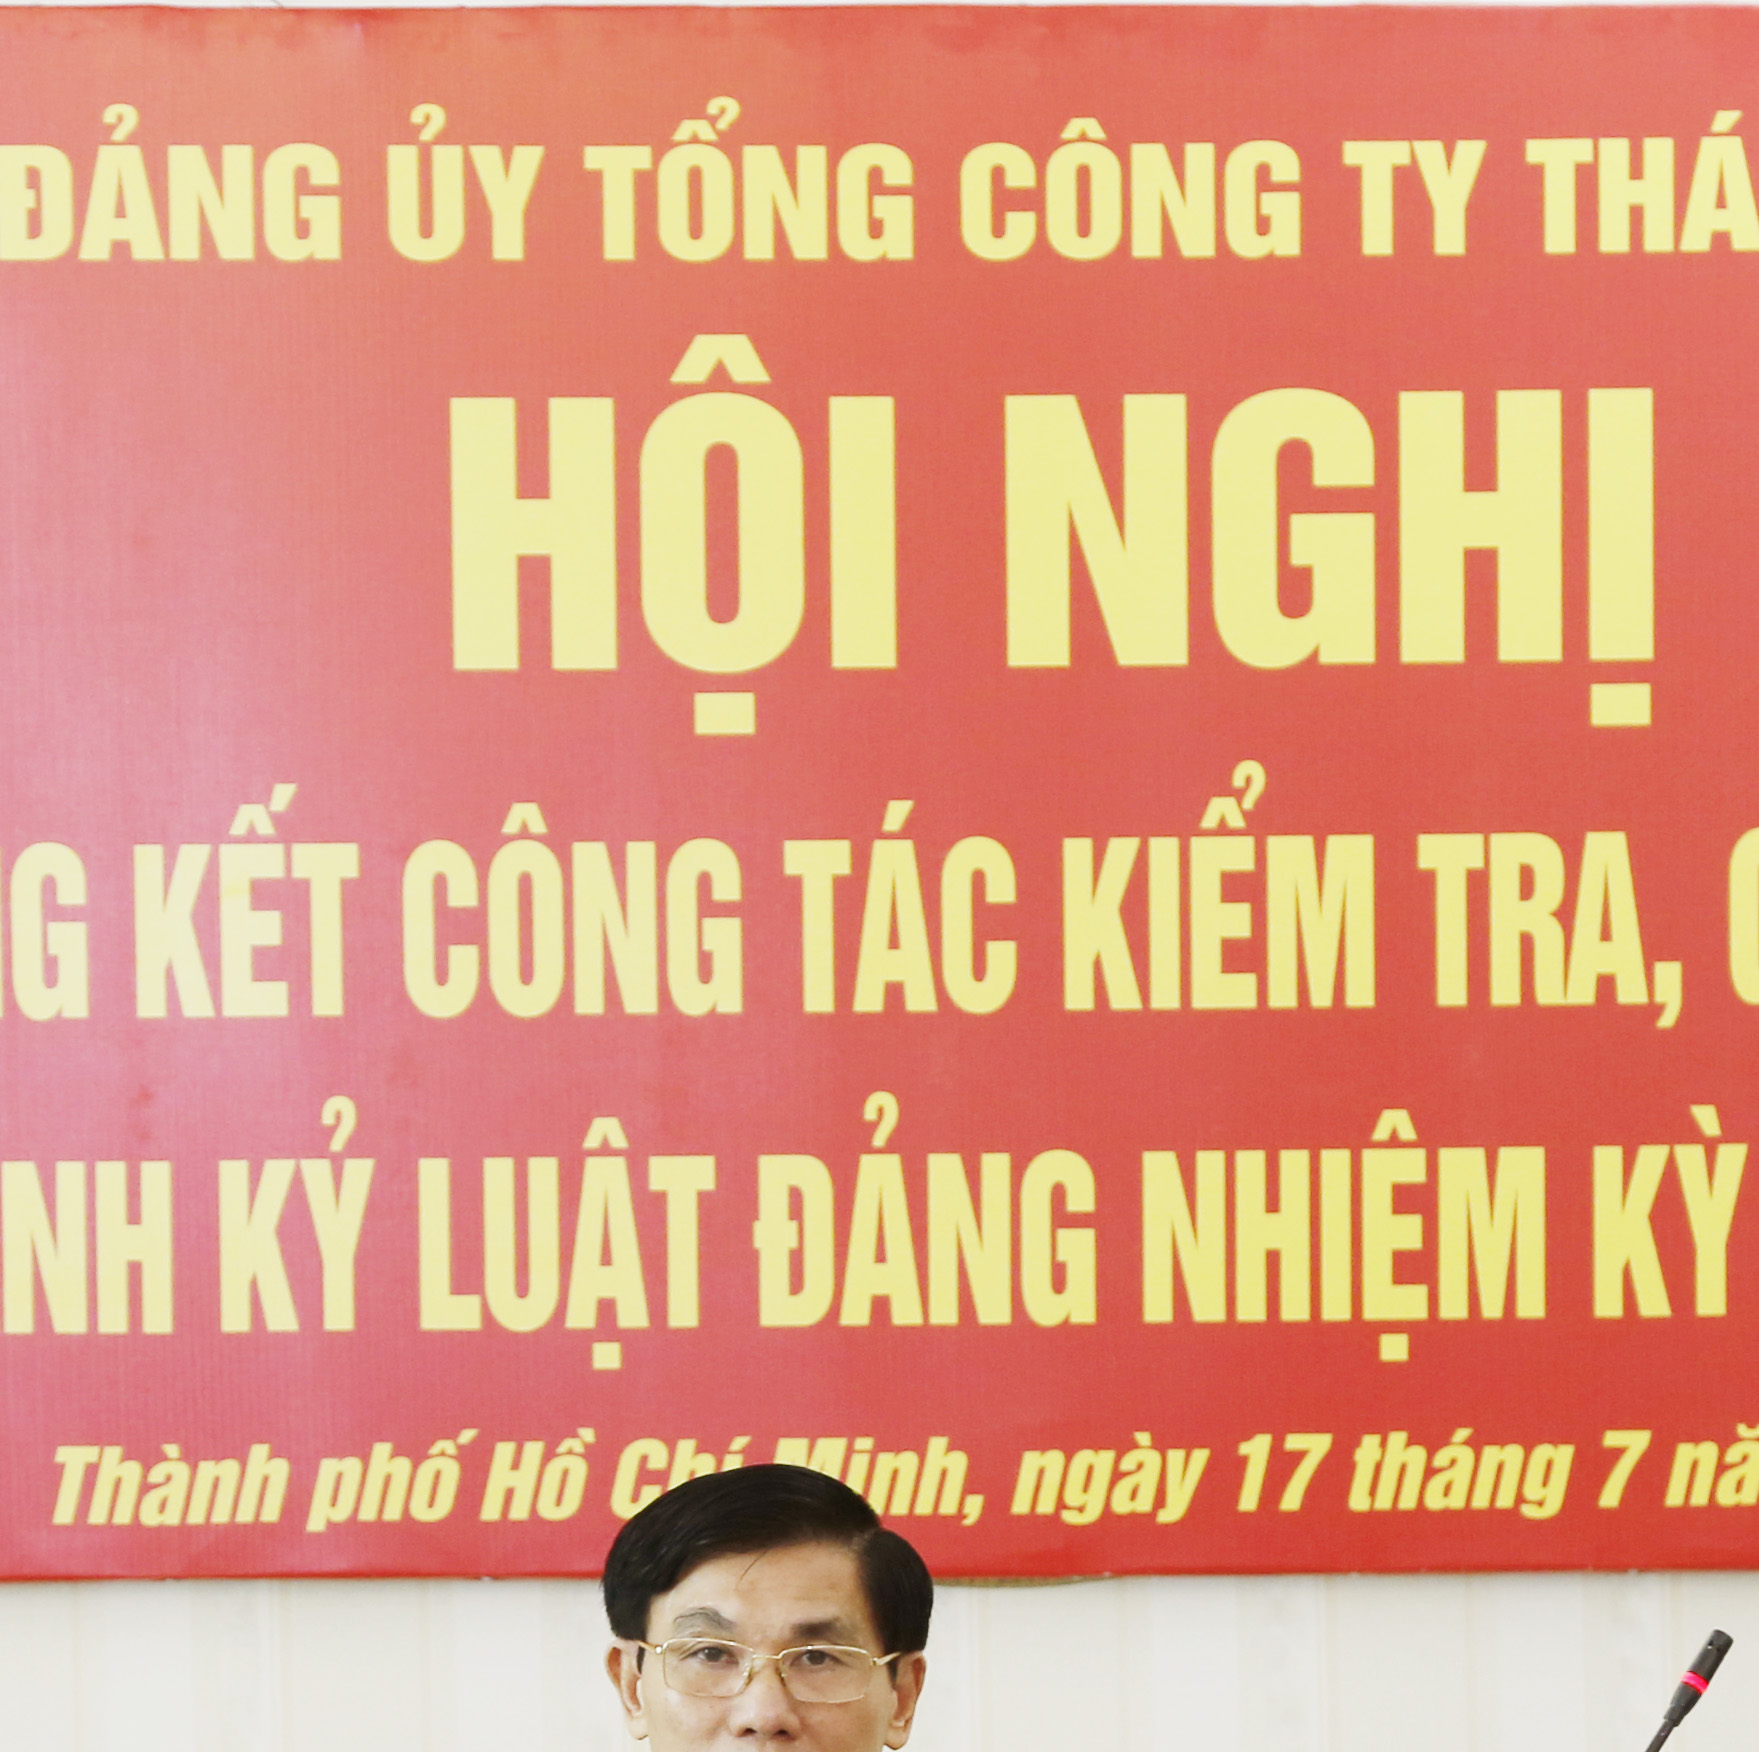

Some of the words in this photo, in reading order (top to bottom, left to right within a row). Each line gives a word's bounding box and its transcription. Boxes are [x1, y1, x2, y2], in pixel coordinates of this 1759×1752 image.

[385, 102, 547, 264] ỦY
[582, 95, 916, 263] TỔNG
[959, 117, 1302, 263] CÔNG
[1341, 138, 1489, 257] TY
[448, 333, 899, 737] HỘI
[1003, 386, 1656, 728] NGHỊ
[133, 783, 362, 1019] KẾT
[401, 802, 745, 1020] CÔNG
[782, 799, 1017, 1015] TÁC
[1062, 759, 1376, 1012] KIỂM
[1416, 831, 1683, 1029] TRA,
[217, 1095, 378, 1335] KỶ
[417, 1116, 718, 1371] LUẬT
[750, 1091, 1098, 1329] ĐẢNG
[1141, 1108, 1547, 1362] NHIỆM
[1593, 1104, 1748, 1320] KỲ
[52, 1443, 292, 1527] Thành
[305, 1428, 480, 1533] phố
[479, 1427, 597, 1523] Hồ
[1011, 1431, 1210, 1525] ngày
[1237, 1433, 1333, 1512] 17
[1348, 1427, 1575, 1520] tháng
[1598, 1430, 1652, 1508] 7
